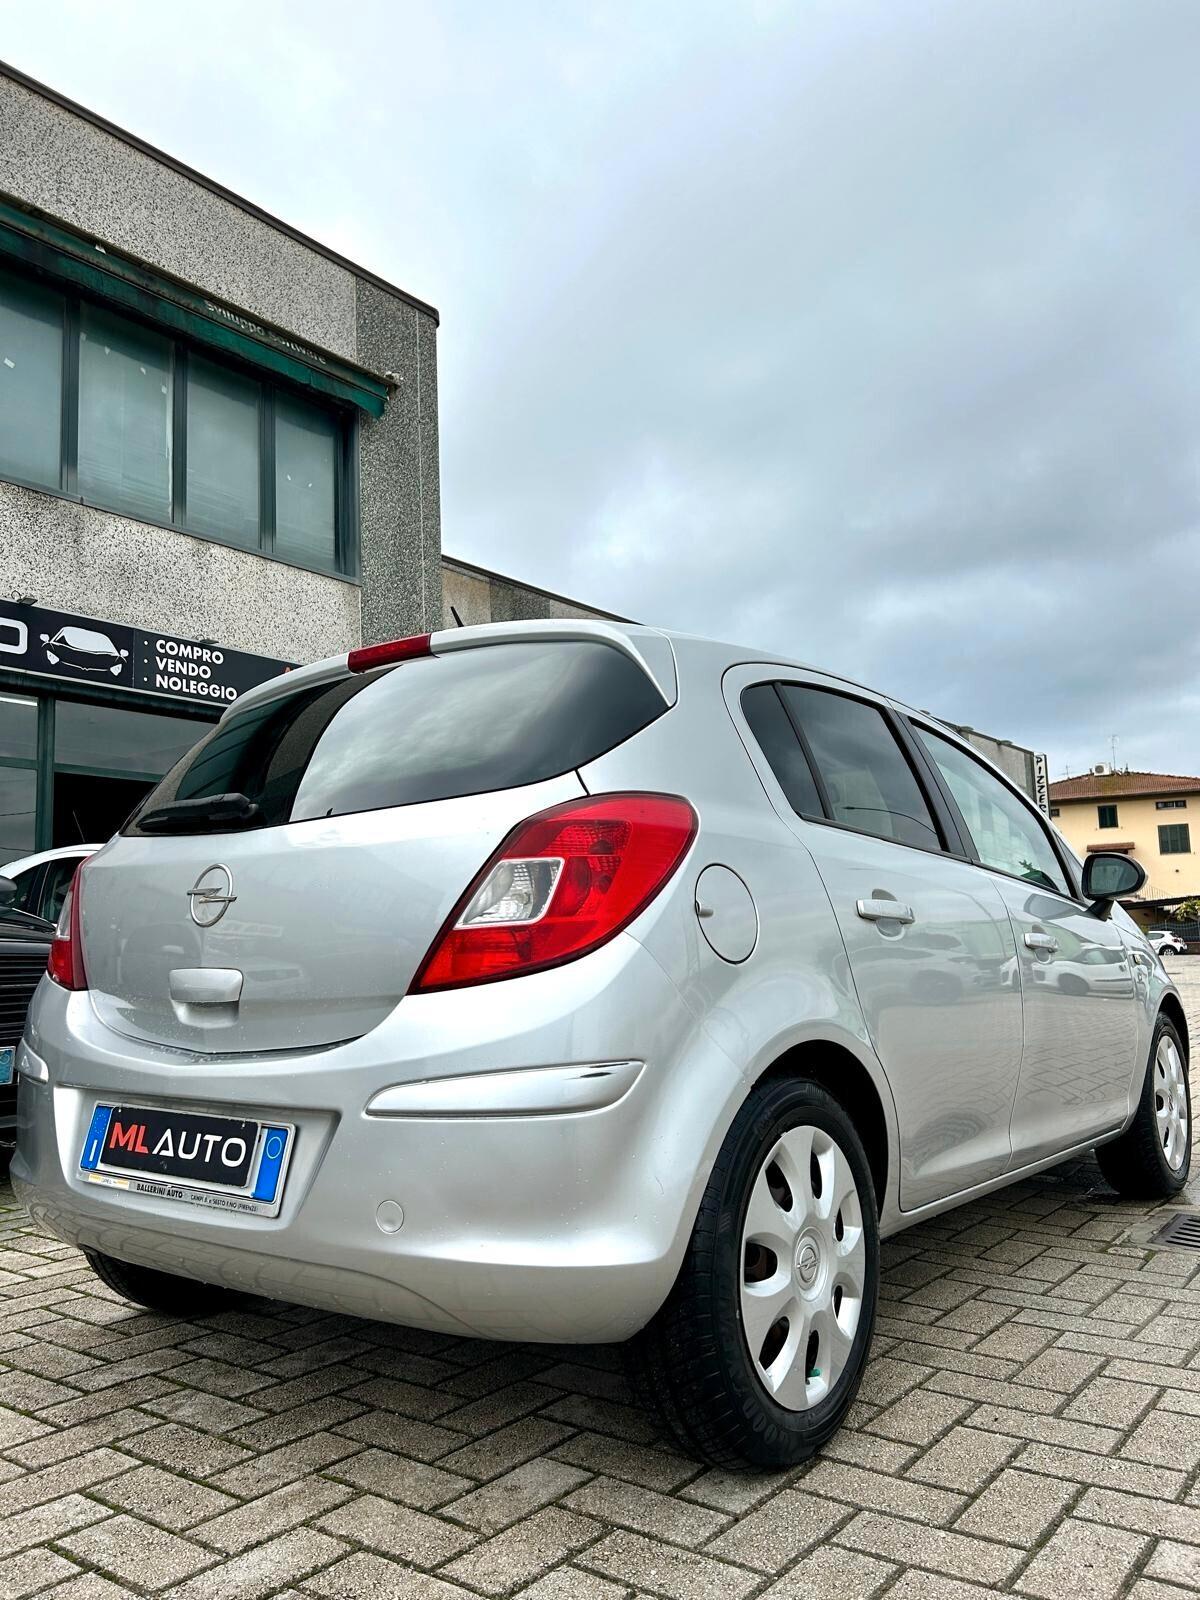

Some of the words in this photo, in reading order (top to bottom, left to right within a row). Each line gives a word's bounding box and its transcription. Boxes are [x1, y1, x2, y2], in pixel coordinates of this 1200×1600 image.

[155, 639, 224, 665] COMPRO
[155, 657, 212, 680] VENDO
[155, 675, 238, 701] NOLEGGIO
[109, 1122, 149, 1154] ML
[152, 1128, 247, 1168] AUTO
[136, 1183, 166, 1196] BALLERINI
[166, 1188, 183, 1199] AUTO
